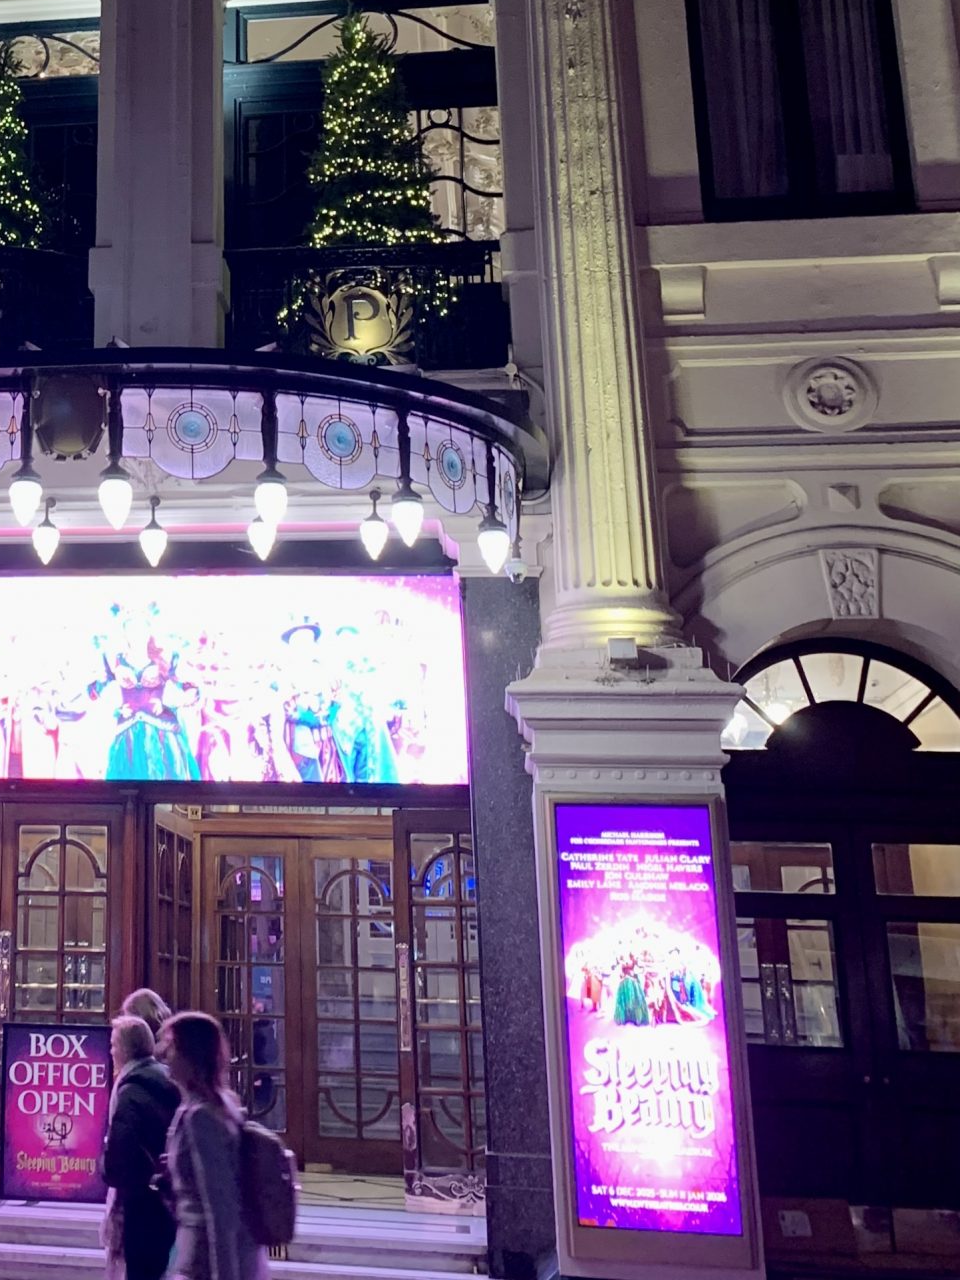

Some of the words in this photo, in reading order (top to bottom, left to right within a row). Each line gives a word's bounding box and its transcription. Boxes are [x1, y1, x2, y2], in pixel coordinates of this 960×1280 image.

[343, 292, 380, 341] P
[30, 1033, 88, 1058] BOX
[9, 1061, 107, 1088] OFFICE
[17, 1090, 96, 1116] OPEN
[16, 1150, 56, 1173] Sleeping
[57, 1155, 96, 1176] Beauty
